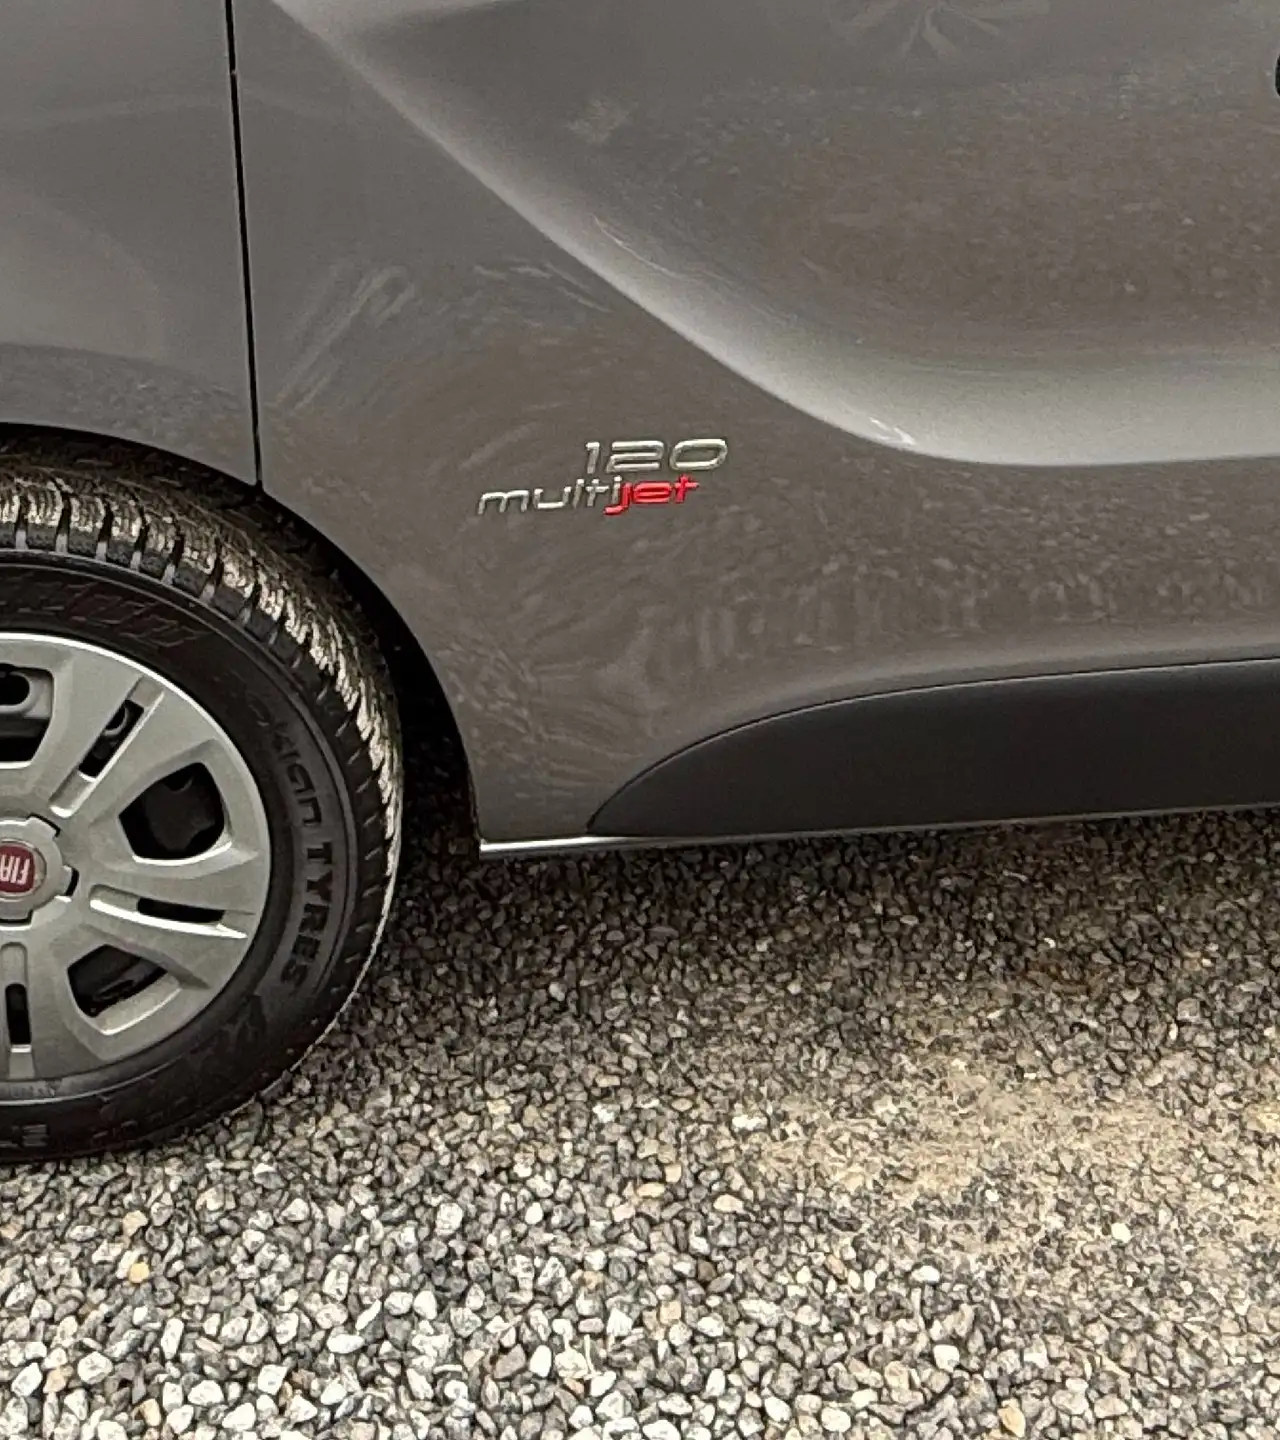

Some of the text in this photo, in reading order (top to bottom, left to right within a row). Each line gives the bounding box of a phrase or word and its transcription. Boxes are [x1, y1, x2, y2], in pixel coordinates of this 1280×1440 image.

[585, 438, 729, 474] 120
[477, 474, 700, 516] multijet
[279, 840, 334, 990] TYRES
